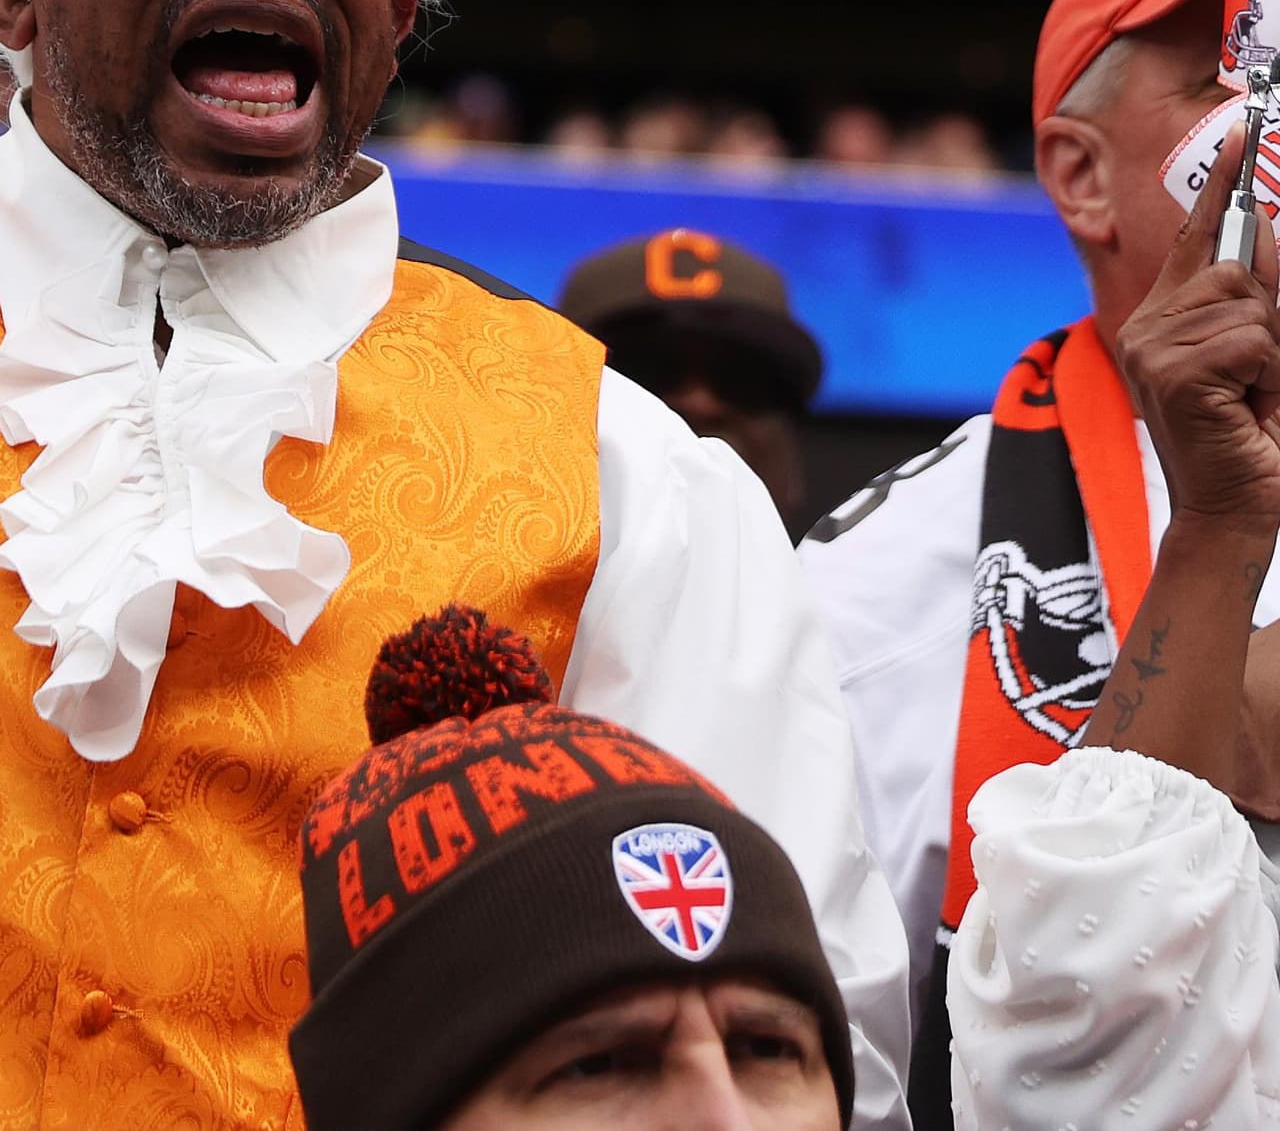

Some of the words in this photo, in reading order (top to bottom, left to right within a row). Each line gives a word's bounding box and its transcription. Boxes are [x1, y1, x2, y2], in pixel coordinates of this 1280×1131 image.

[644, 229, 722, 300] C
[337, 734, 720, 950] LOND
[627, 832, 702, 858] LONDON
